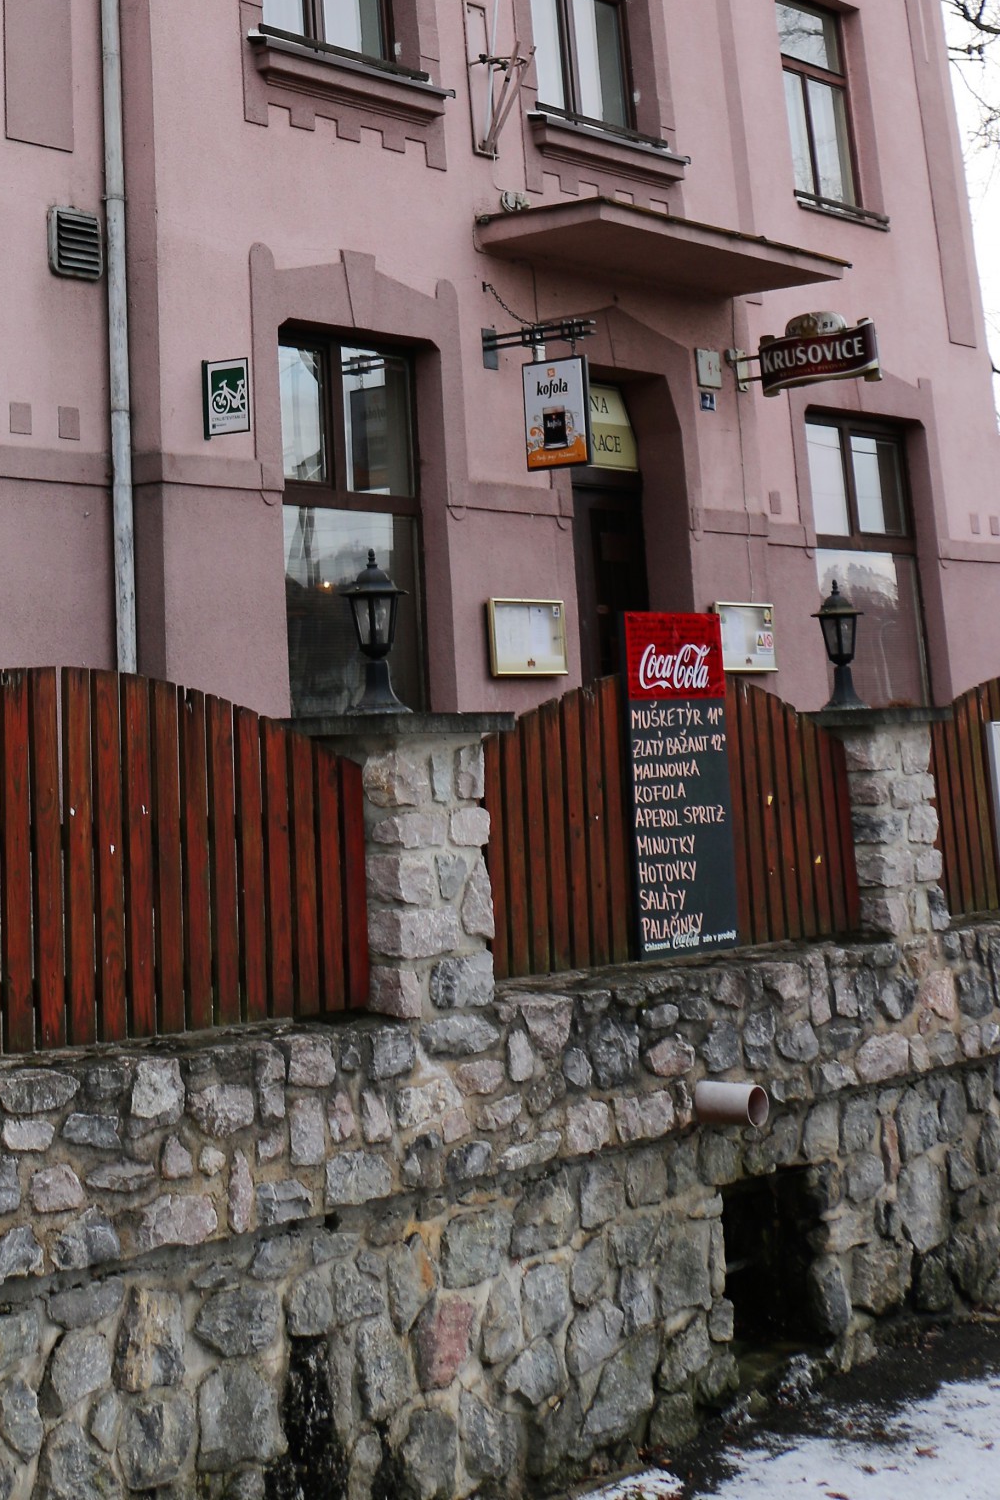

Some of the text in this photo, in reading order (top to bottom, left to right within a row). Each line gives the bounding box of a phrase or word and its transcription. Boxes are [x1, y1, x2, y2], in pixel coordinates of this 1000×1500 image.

[761, 336, 865, 374] KRUŠOVICE
[536, 378, 568, 398] kofola
[631, 701, 704, 730] MUŠKETÝR
[632, 730, 663, 758] ZLATÝ
[666, 728, 709, 756] BAŽANT
[633, 759, 700, 782] MALINOVKA
[634, 782, 686, 804] KOFOLA
[635, 804, 726, 828] APEROL SPRITZ
[636, 834, 696, 857] MINUTKY
[638, 861, 696, 884] HOTOVKY
[639, 884, 686, 911] SALÁTY
[641, 912, 703, 941] PALAČINKY
